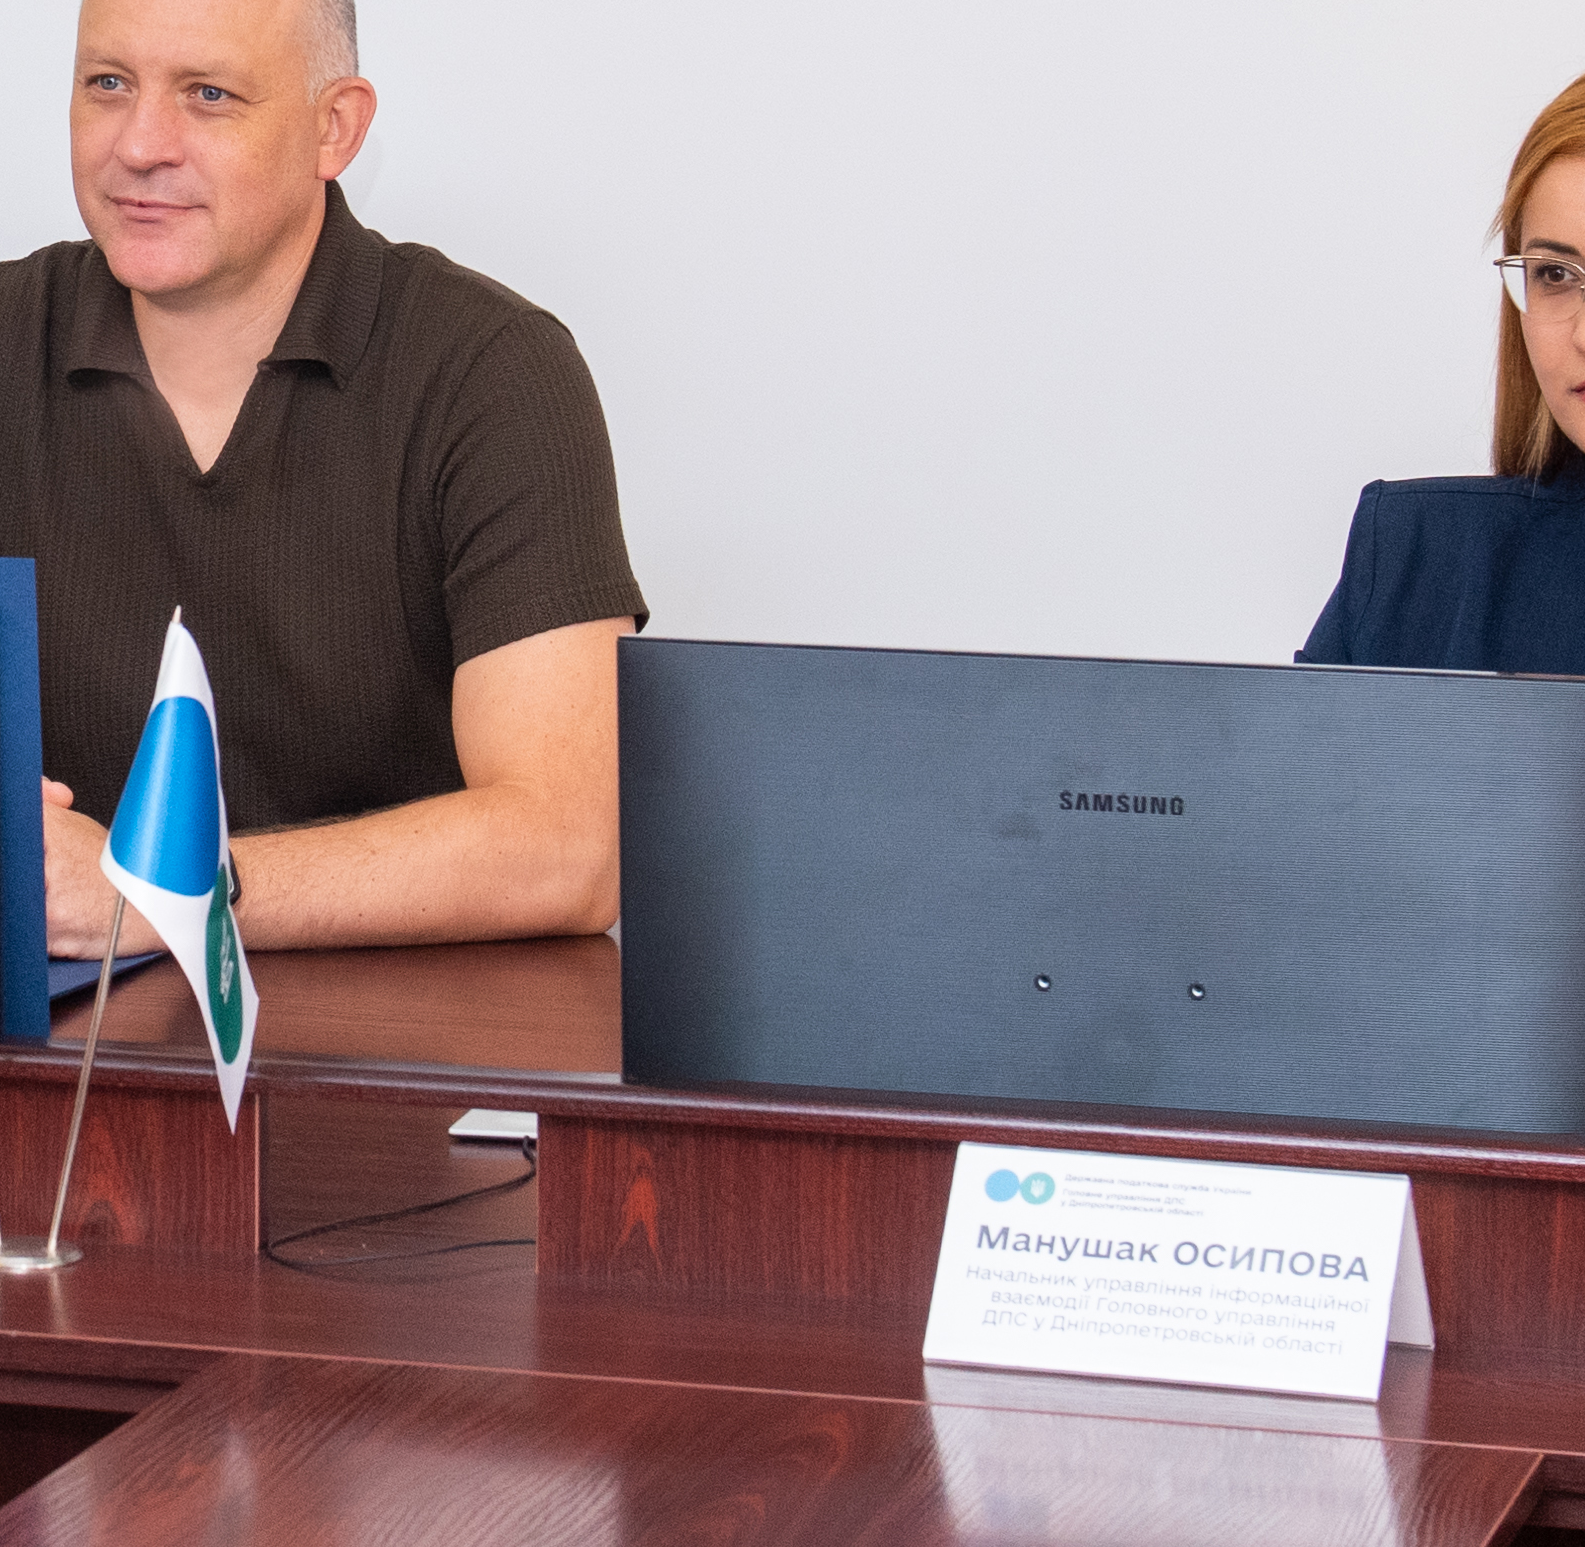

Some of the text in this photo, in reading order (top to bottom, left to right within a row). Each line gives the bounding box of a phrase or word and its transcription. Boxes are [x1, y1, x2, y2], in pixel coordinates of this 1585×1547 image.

[1059, 790, 1185, 815] SAMSUNG
[977, 1224, 1369, 1282] Манушак ОСИПОВА
[966, 1265, 1371, 1314] Начальник управління інформаційної
[990, 1290, 1335, 1332] взаємодії Головного управління
[982, 1309, 1344, 1356] ДПС у Дніпропетровській області
